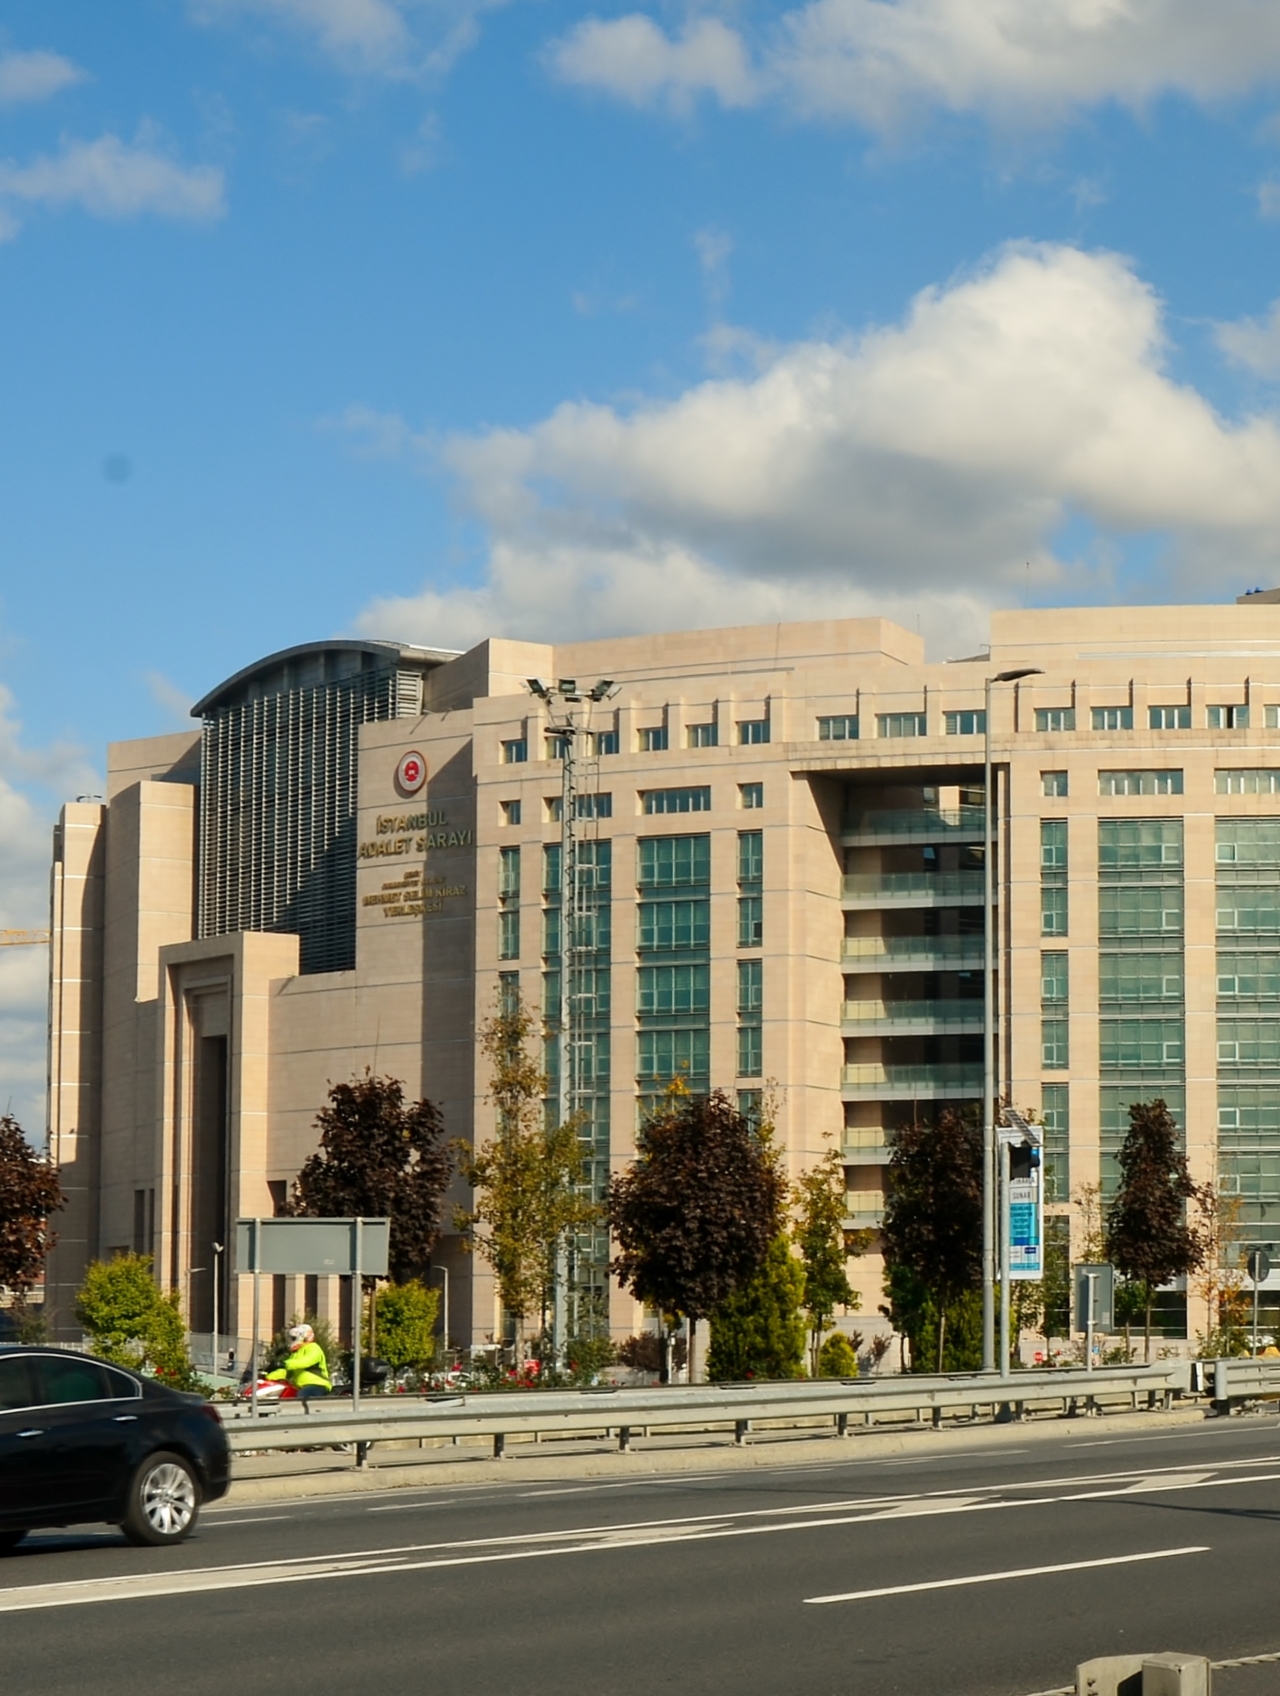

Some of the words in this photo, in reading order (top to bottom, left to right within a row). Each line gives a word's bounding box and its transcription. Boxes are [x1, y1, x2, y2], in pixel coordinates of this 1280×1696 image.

[376, 811, 448, 835] İSTANBUL
[359, 836, 413, 860] ADALET
[415, 829, 473, 853] SARAYI
[435, 885, 466, 898] KİRAZ
